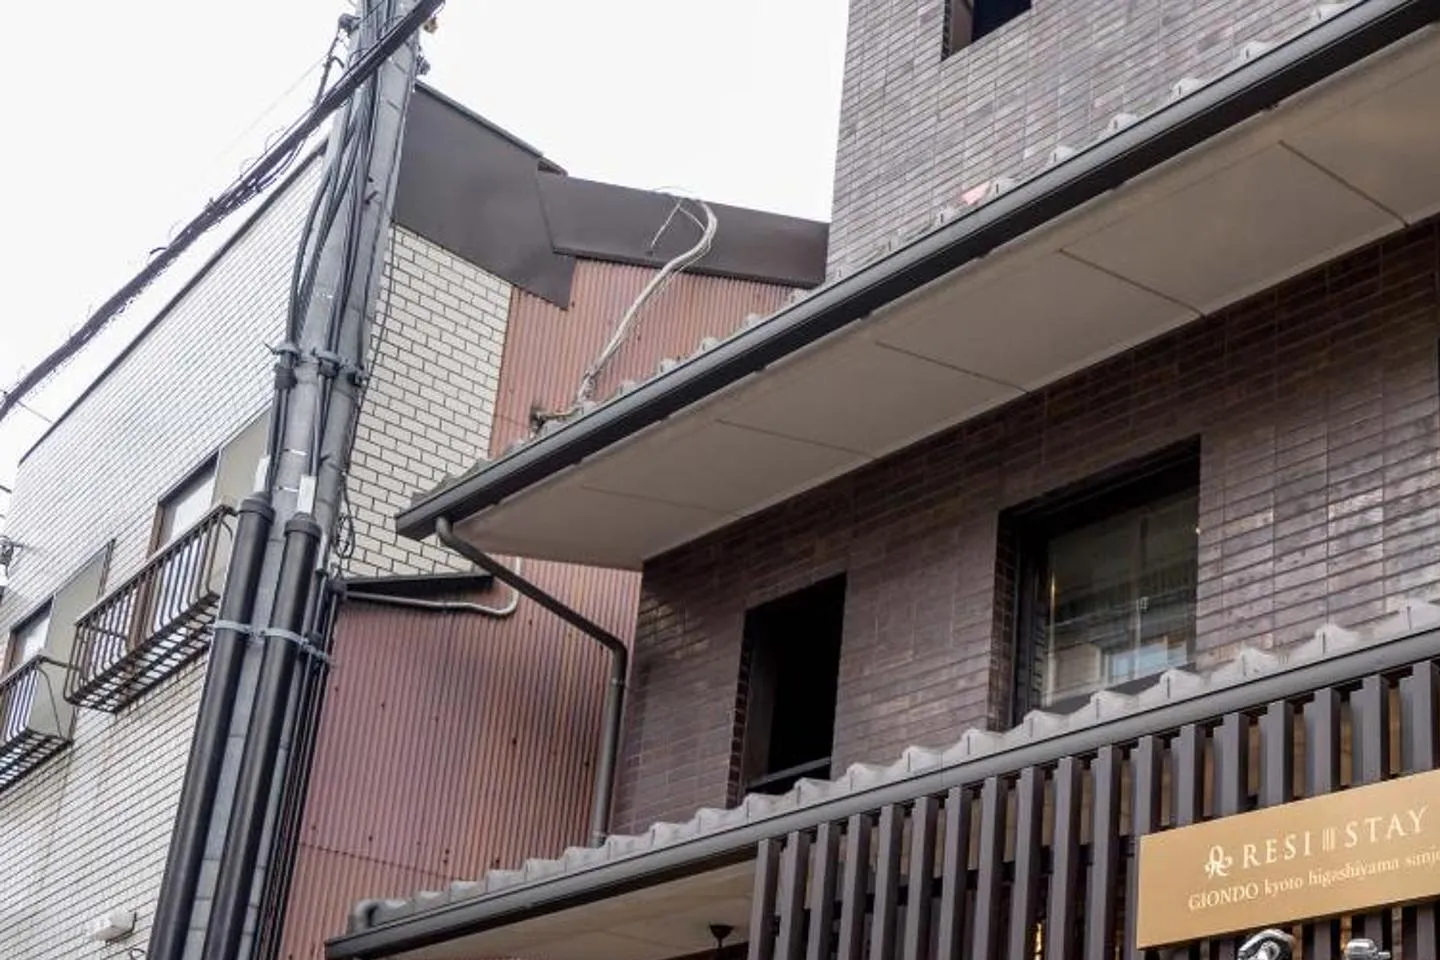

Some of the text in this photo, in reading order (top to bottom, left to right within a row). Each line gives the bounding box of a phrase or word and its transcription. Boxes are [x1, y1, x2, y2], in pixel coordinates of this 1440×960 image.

[1241, 804, 1429, 869] RESI STAY
[1187, 880, 1259, 912] GIONDO
[1264, 875, 1303, 897] kyoto
